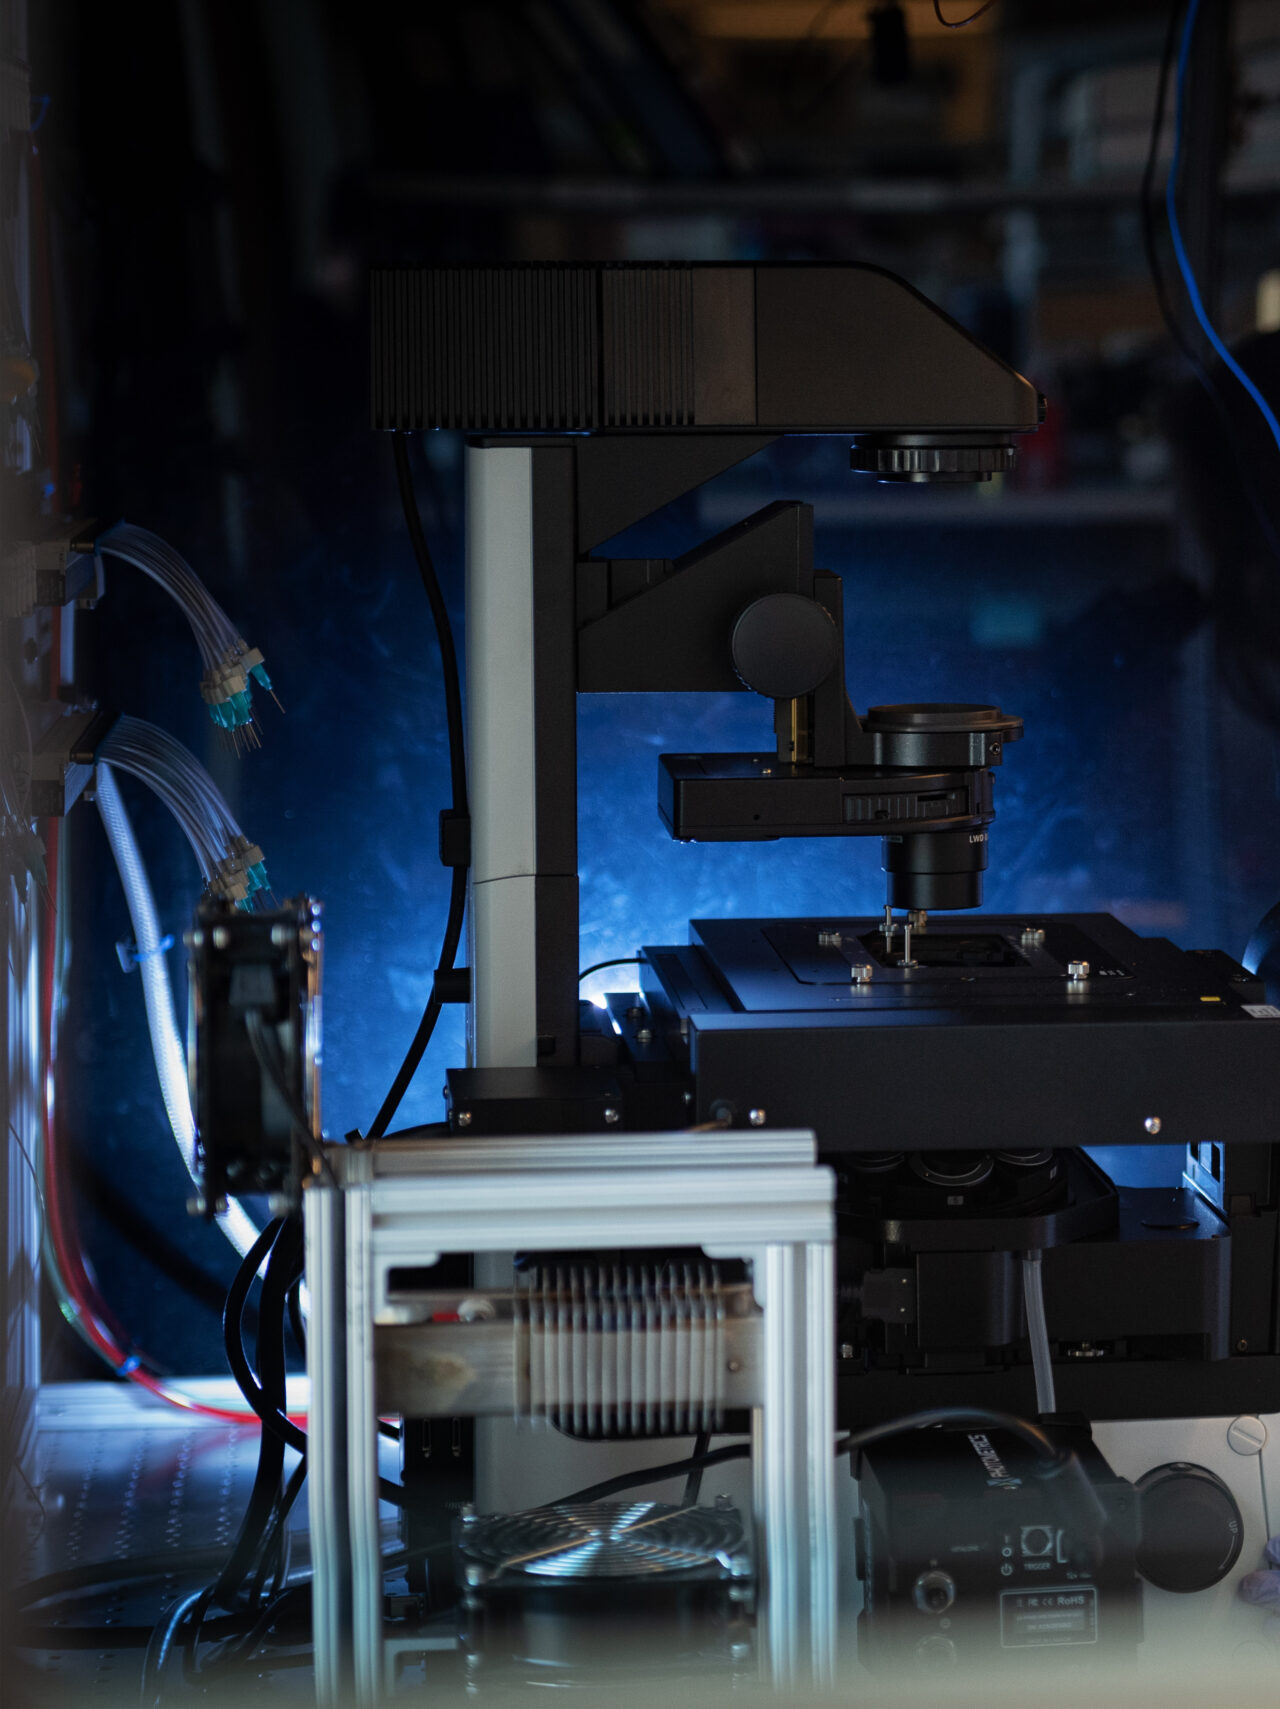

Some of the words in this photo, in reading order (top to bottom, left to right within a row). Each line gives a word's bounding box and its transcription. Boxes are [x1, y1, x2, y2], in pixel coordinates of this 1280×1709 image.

[969, 833, 984, 844] LWD
[967, 1433, 1010, 1479] PHOTOMETRICS
[1228, 1520, 1239, 1534] UP
[1024, 1561, 1051, 1571] TRIGGER
[1057, 1595, 1085, 1608] RoHS
